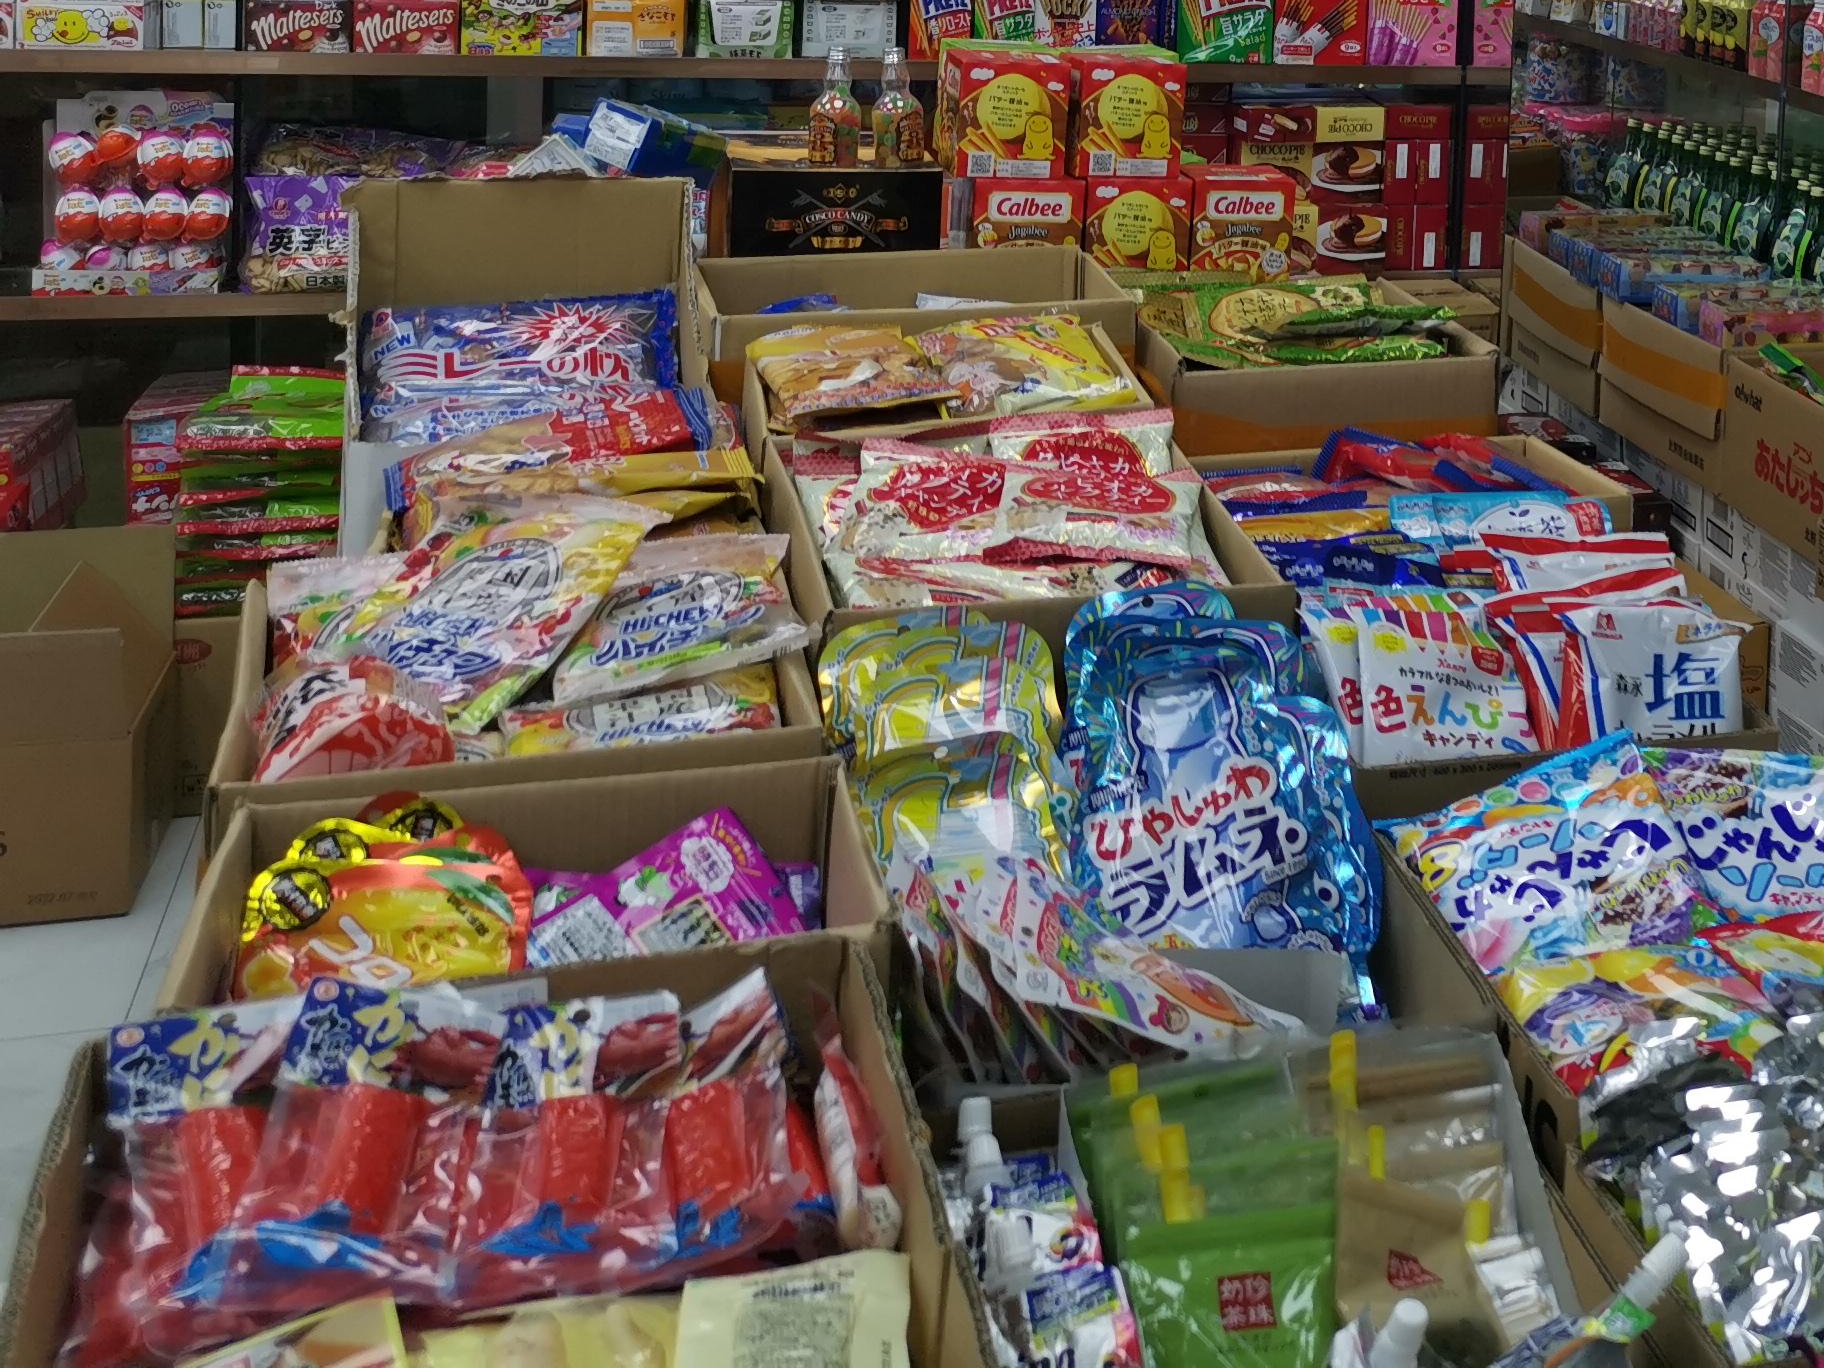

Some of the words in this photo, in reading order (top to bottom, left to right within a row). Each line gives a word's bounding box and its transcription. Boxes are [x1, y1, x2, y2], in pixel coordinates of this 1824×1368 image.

[251, 6, 343, 49] Maltesers
[356, 6, 455, 51] Maltesers
[836, 209, 871, 223] CANDY
[996, 195, 1065, 218] Calbee
[1213, 194, 1277, 216] Calbee
[1008, 224, 1049, 239] Jagabee
[1224, 223, 1264, 237] Jagabee
[373, 332, 413, 361] NEW
[1646, 651, 1726, 720] 塩
[1370, 683, 1538, 732] 色えんぴつ
[1422, 730, 1495, 749] キャンディ
[1092, 764, 1274, 861] ひやしゅわ
